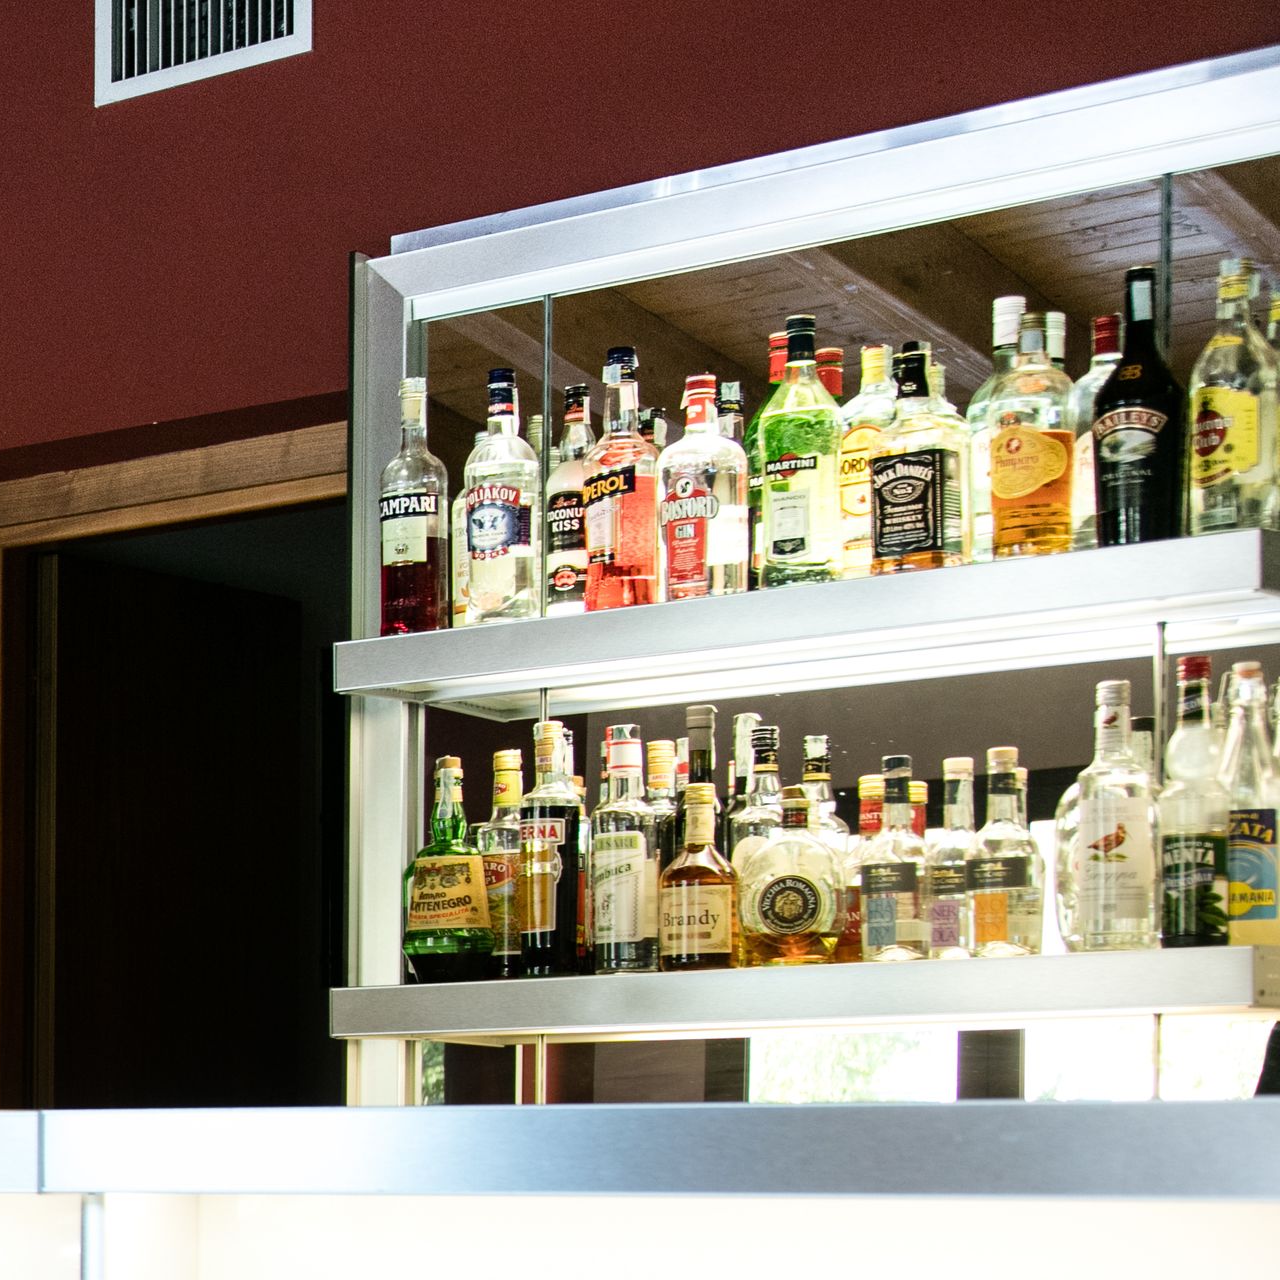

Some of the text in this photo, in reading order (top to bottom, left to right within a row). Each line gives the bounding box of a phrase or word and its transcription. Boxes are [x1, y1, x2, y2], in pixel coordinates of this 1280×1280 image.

[1097, 411, 1162, 435] BAILEYS
[766, 458, 816, 473] MARTINI
[582, 474, 629, 503] PEROL
[660, 494, 718, 527] BOSFORD
[551, 519, 581, 533] KISS
[675, 524, 695, 540] GIN
[474, 548, 506, 560] VODKA
[521, 823, 560, 842] ERNA
[594, 861, 633, 885] mbuca
[761, 878, 817, 912] VECCHIA ROMAGNA
[662, 909, 721, 930] Brandy
